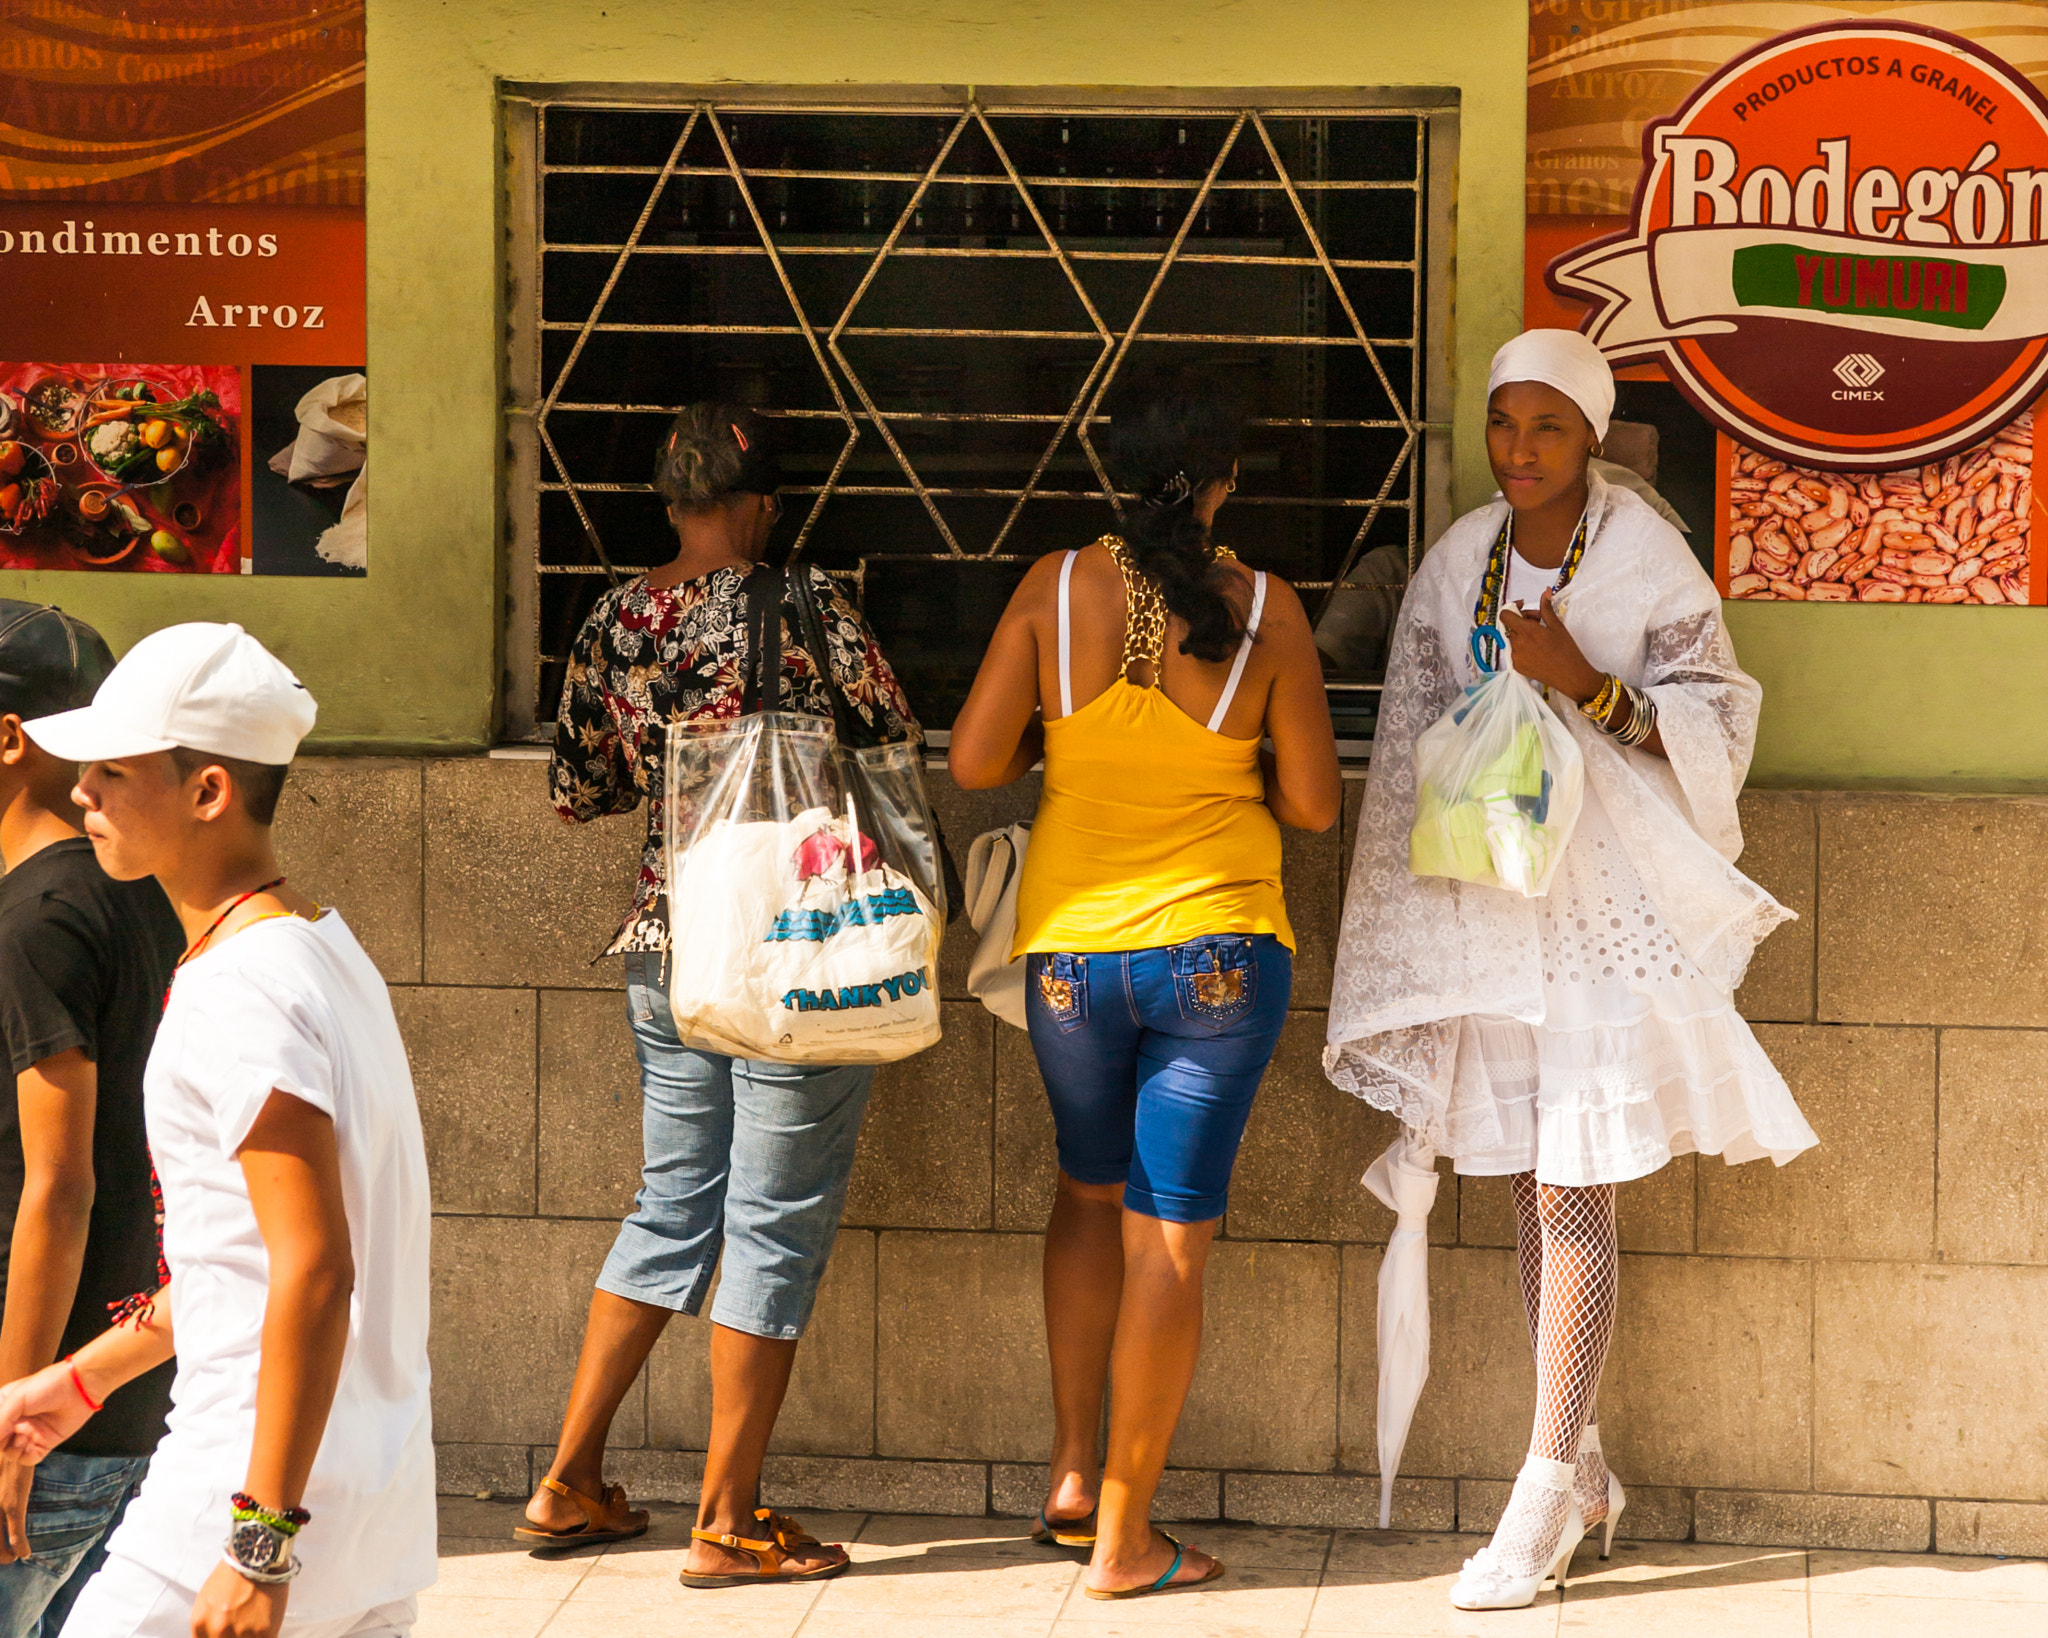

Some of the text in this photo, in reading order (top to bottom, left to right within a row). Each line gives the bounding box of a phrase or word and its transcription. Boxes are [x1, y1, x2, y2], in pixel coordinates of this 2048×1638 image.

[1551, 63, 1666, 99] Arroz
[1732, 56, 1999, 125] PRODUCTOS A GRANEL
[1534, 147, 1619, 170] Granos
[1662, 135, 2048, 246] Bodegón
[0, 220, 278, 257] ondimentos
[1794, 253, 1969, 314] YUMURI
[185, 295, 325, 328] Arroz
[1832, 390, 1885, 402] CIMEX
[780, 984, 882, 1012] THANK
